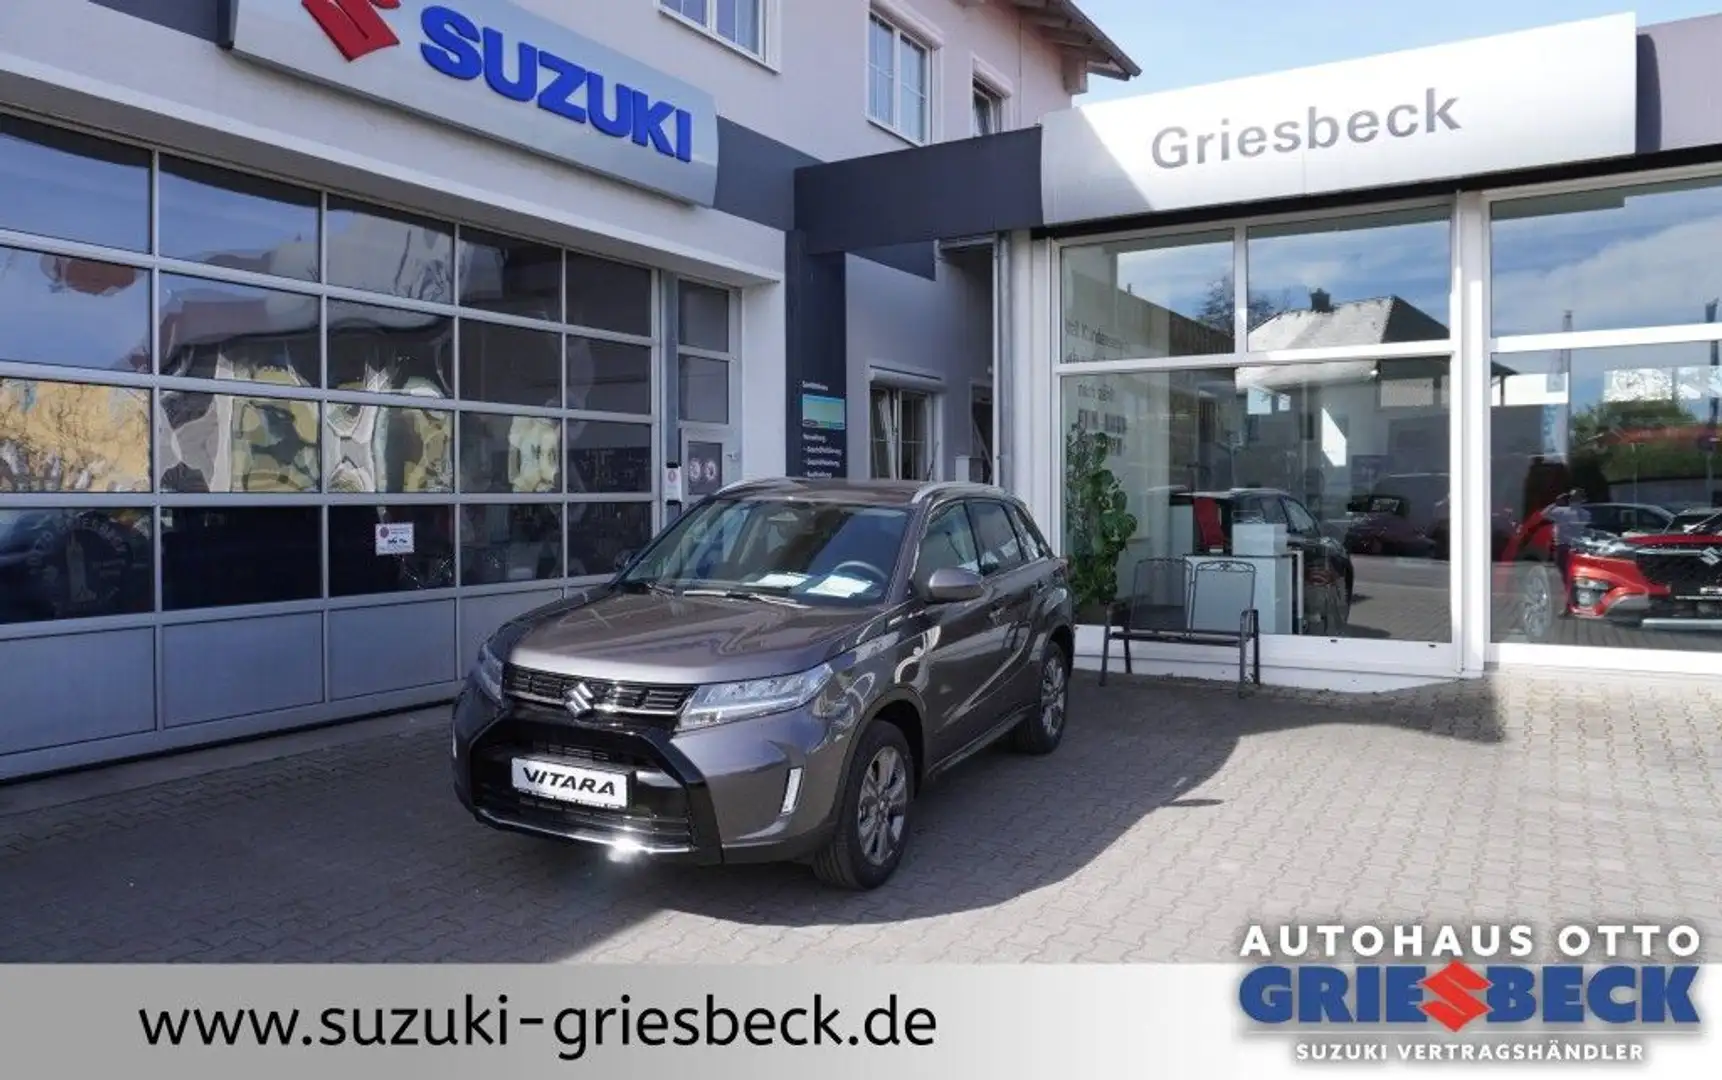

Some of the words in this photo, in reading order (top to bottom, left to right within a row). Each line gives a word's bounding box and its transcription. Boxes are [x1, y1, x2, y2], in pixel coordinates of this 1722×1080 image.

[420, 5, 692, 163] SUZUKI
[1151, 87, 1462, 170] Griesbeck
[522, 766, 616, 797] VITARA
